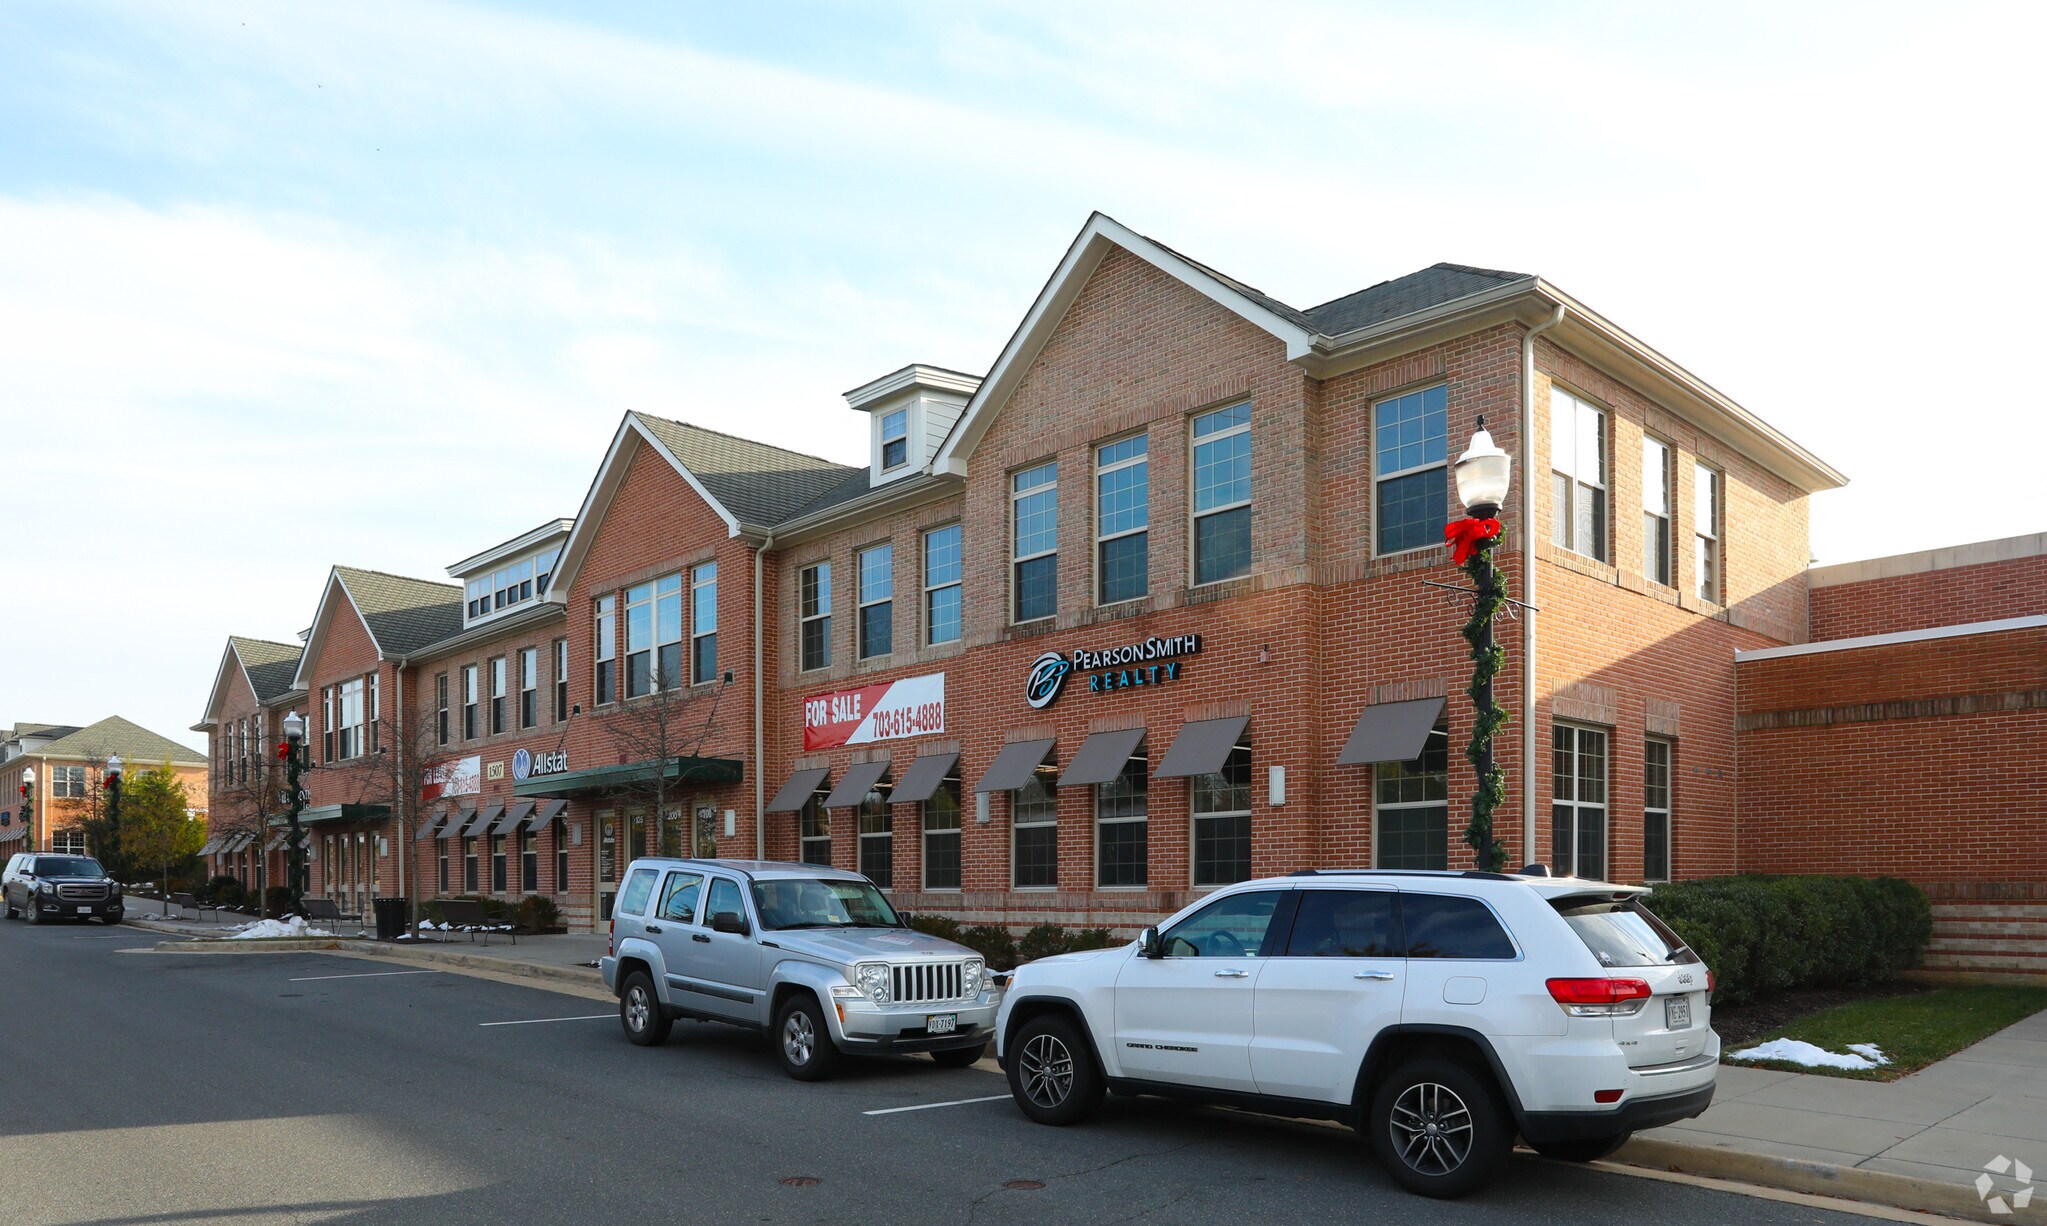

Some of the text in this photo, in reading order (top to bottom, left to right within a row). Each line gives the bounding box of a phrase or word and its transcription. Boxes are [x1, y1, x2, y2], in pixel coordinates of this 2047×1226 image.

[1090, 662, 1177, 692] REALTY
[805, 692, 862, 728] FOR SALE
[872, 701, 942, 738] 703-615-4888
[488, 763, 503, 779] 1507
[531, 750, 568, 776] Allstat
